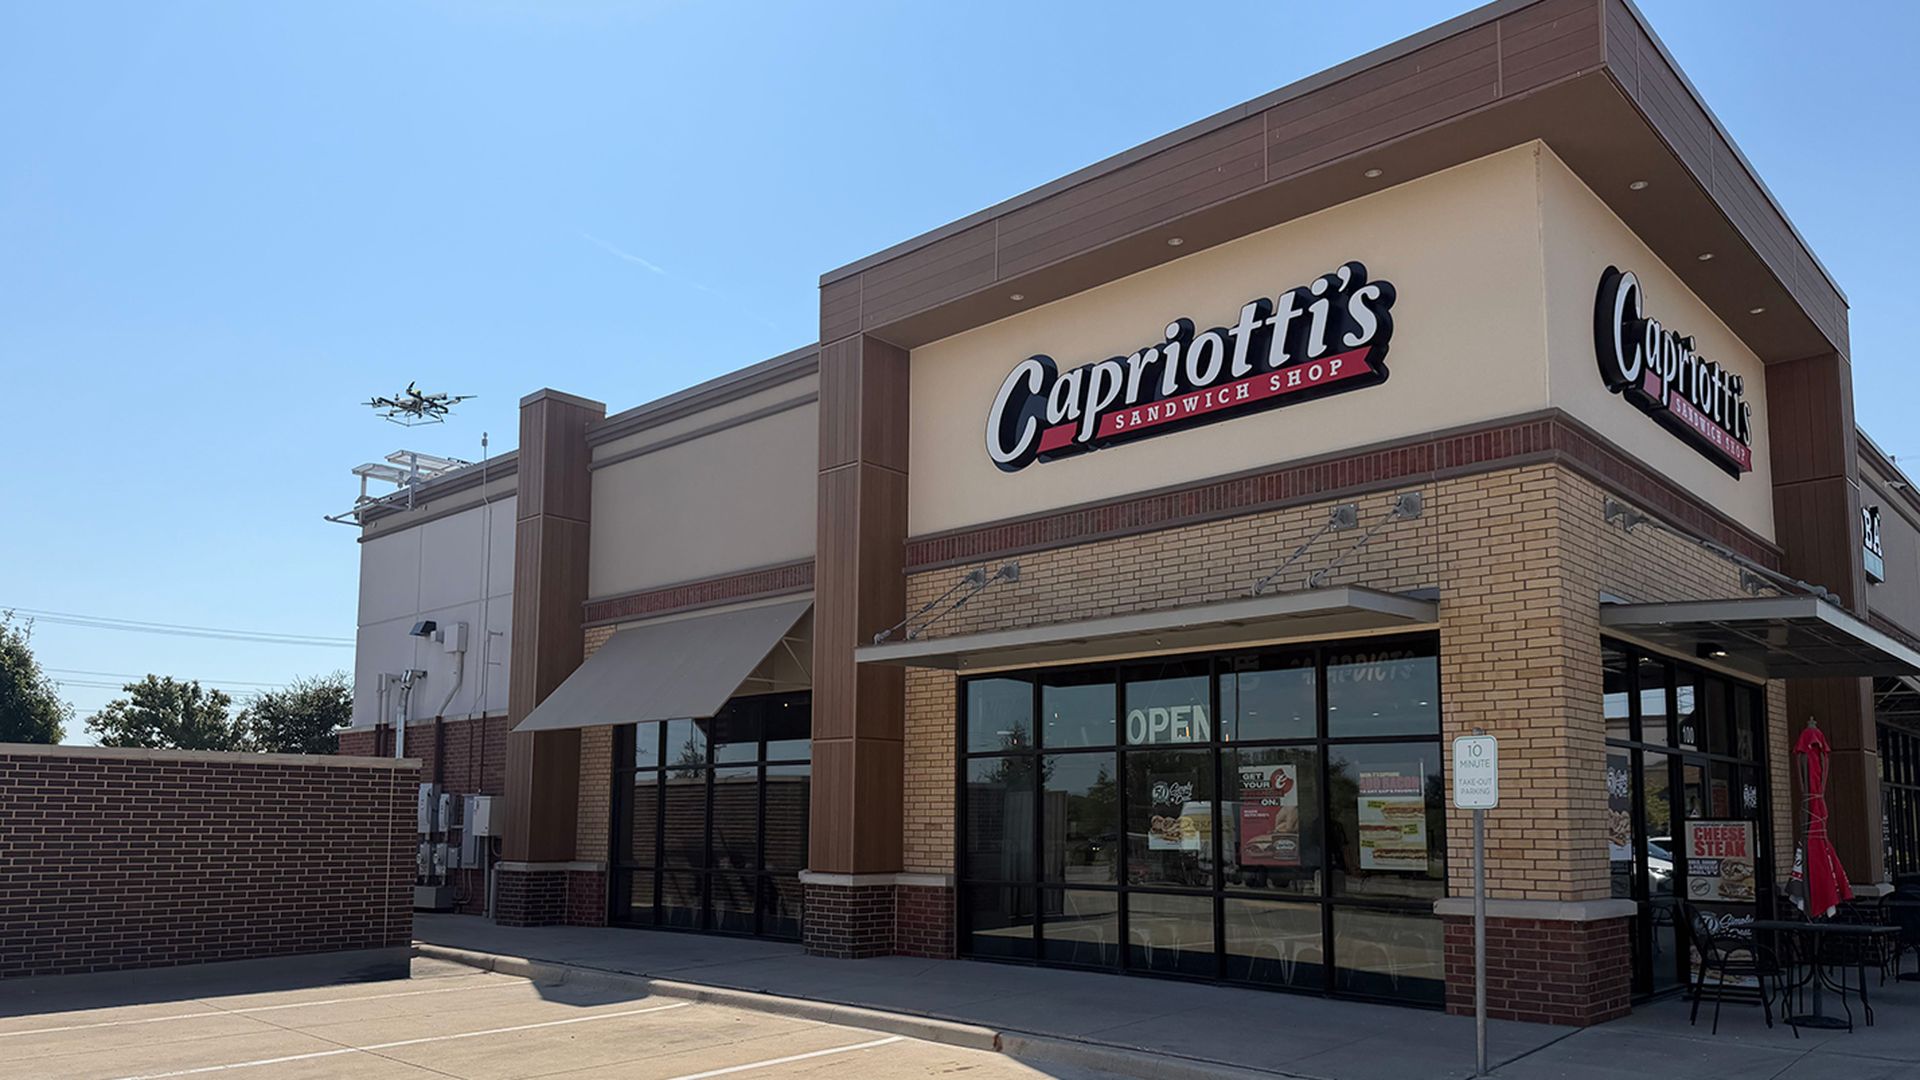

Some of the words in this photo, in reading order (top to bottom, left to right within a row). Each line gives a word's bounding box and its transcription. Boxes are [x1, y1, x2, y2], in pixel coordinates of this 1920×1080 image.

[986, 264, 1381, 463] Capriotti's
[1115, 382, 1250, 429] SANDWICH
[1269, 359, 1345, 392] SHOP
[1675, 397, 1722, 446] SANDWICH
[1725, 436, 1746, 462] SHOP
[1126, 704, 1211, 746] OPEN
[1467, 744, 1482, 757] 10
[1459, 759, 1491, 768] MINUTE
[1243, 781, 1270, 789] YOUR
[1460, 787, 1490, 795] PARKING
[1261, 798, 1279, 806] ON.
[1693, 827, 1746, 841] CHEESE
[1694, 840, 1747, 857] STEAK
